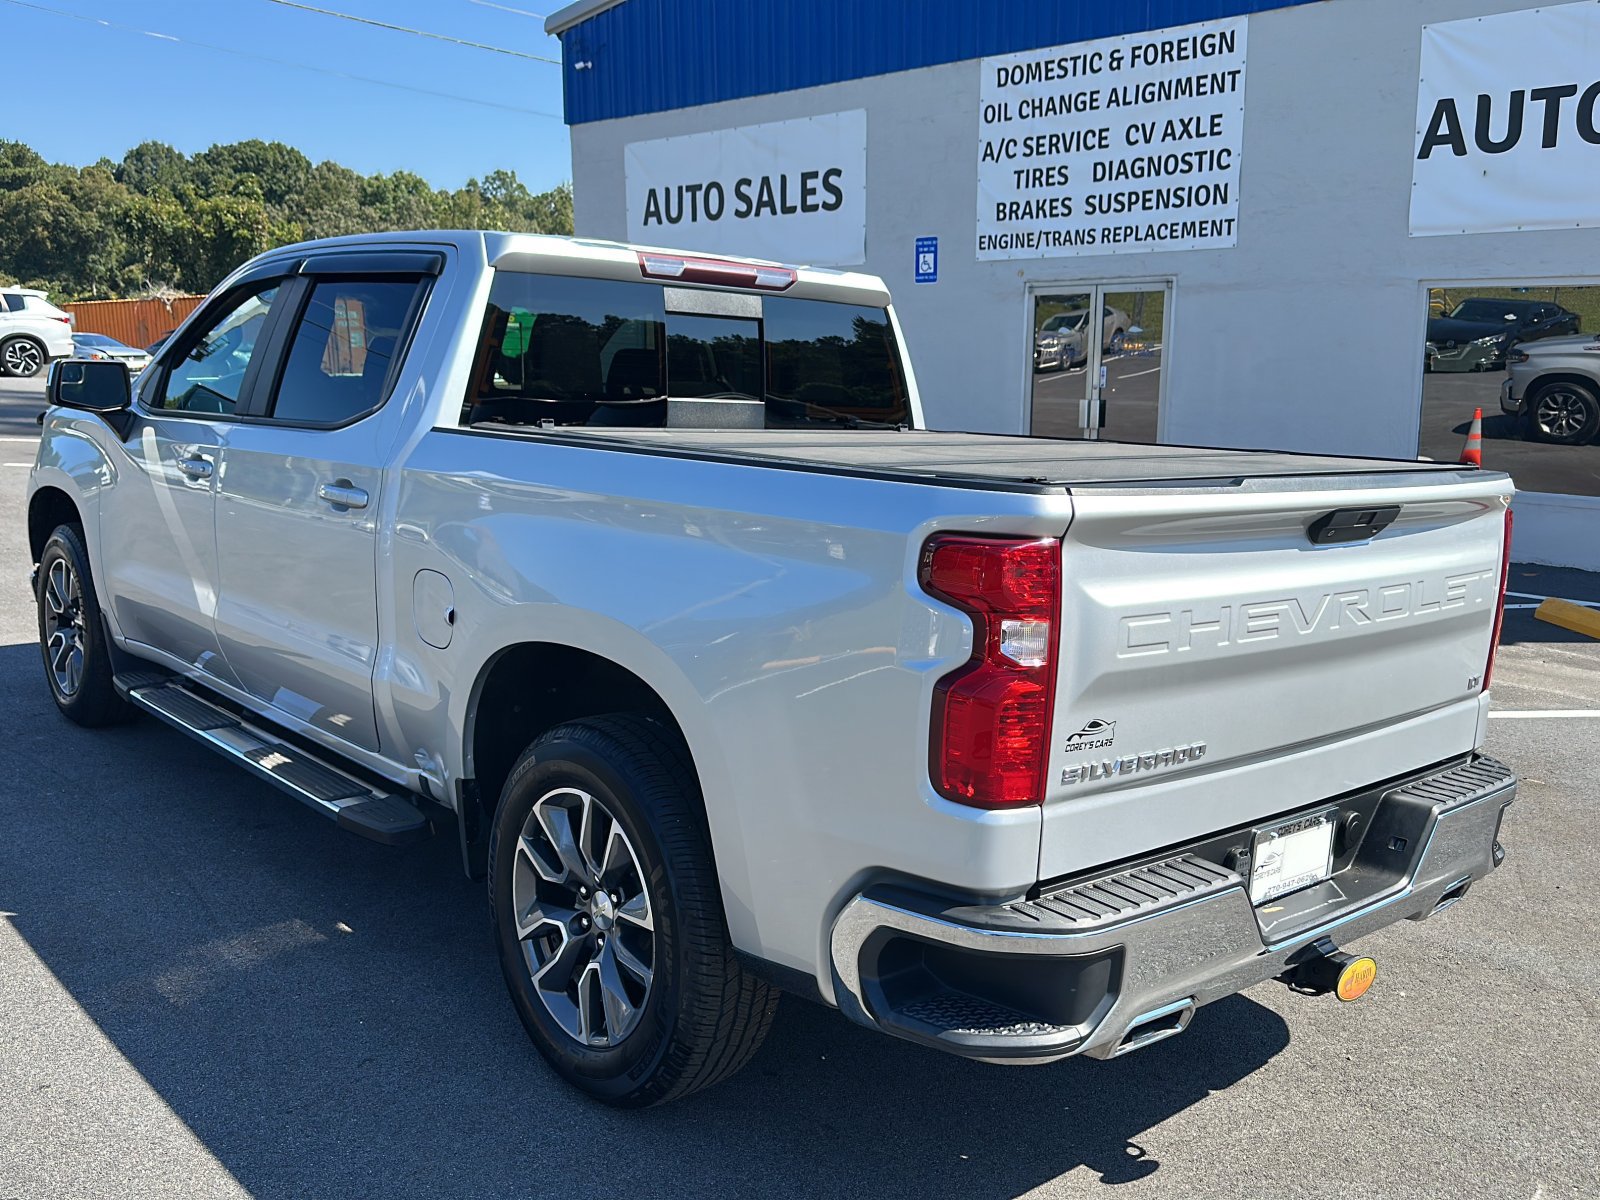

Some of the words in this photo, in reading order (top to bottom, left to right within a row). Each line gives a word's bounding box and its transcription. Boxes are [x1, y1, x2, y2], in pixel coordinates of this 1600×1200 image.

[996, 52, 1103, 89] DOMESTIC
[1108, 48, 1125, 71] &
[1130, 29, 1236, 69] FOREIGN
[983, 102, 1013, 124] OIL
[1018, 90, 1101, 120] CHANGE
[1106, 70, 1242, 109] ALIGNMENT
[982, 138, 1018, 163] A/C
[1022, 127, 1110, 158] SERVICE
[1125, 122, 1156, 146] CV
[1161, 113, 1223, 143] AXLE
[1014, 165, 1069, 190] TIRES
[1092, 148, 1232, 183] DIAGNOSTIC
[643, 181, 725, 226] AUTO
[734, 168, 843, 219] SALES
[996, 196, 1072, 222] BRAKES
[1084, 182, 1229, 216] SUSPENSION
[978, 228, 1096, 251] ENGINE/TRANS
[1100, 218, 1236, 245] REPLACEMENT
[1117, 569, 1493, 658] CHEVROLET
[1061, 742, 1207, 785] SILVERADO
[1065, 741, 1094, 752] COREY'S
[1095, 738, 1113, 748] CARS
